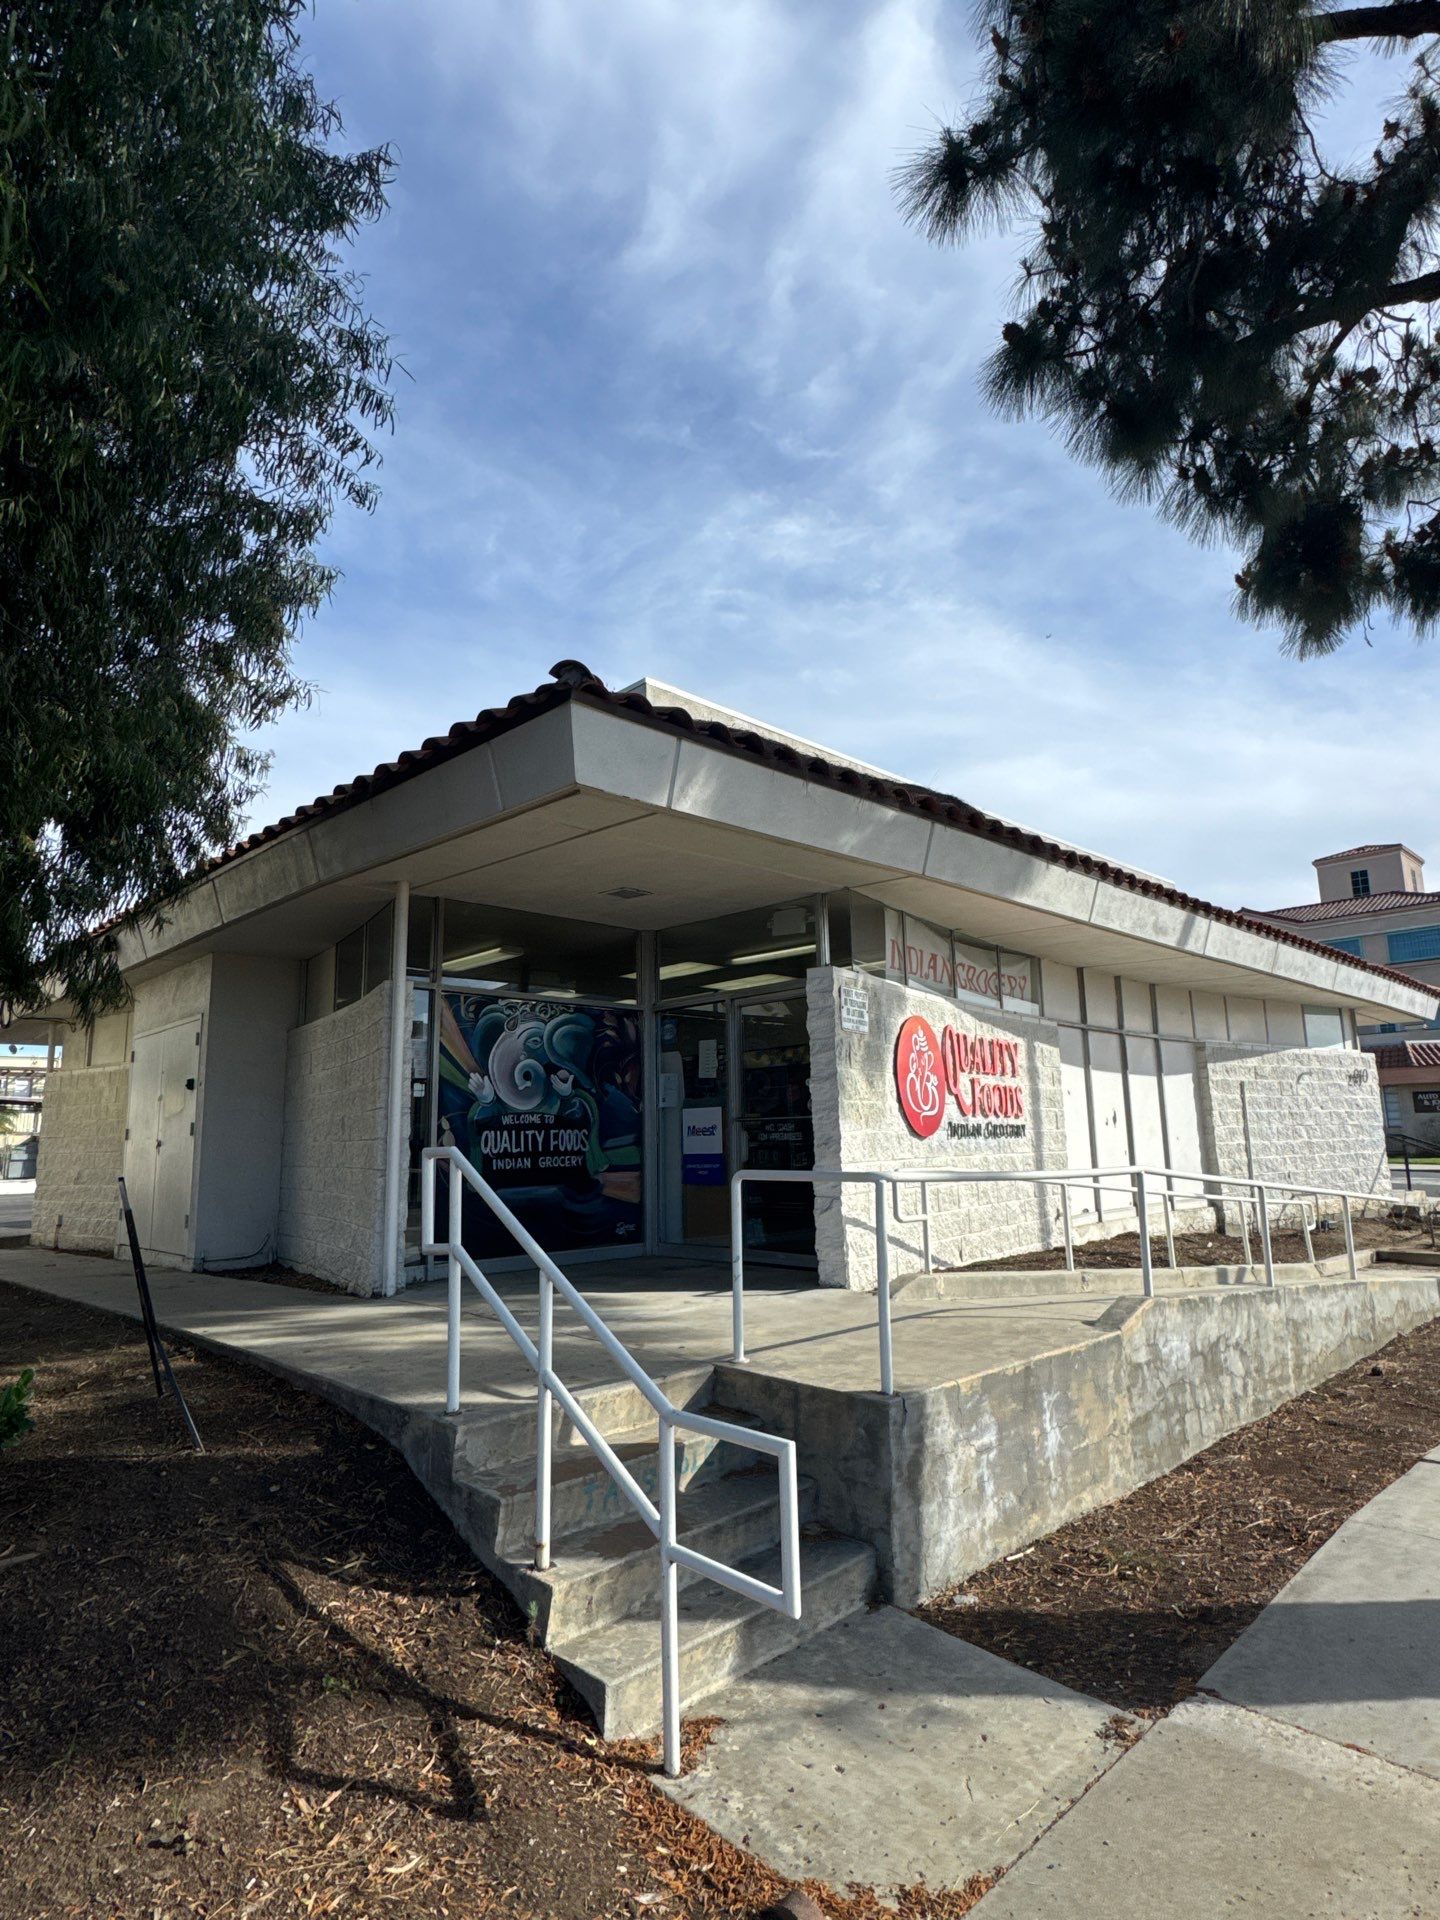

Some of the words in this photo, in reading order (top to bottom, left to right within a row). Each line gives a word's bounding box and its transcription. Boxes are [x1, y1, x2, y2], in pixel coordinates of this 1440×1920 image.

[941, 1024, 1019, 1117] QUALITY
[970, 1078, 1024, 1119] FOODS
[501, 1114, 542, 1125] WELCOME
[544, 1115, 555, 1124] TO
[687, 1125, 715, 1137] Meest
[946, 1121, 983, 1140] INDIAN
[983, 1122, 1026, 1139] GROCERY
[481, 1129, 545, 1158] QUALITY
[550, 1129, 589, 1152] FOODS
[492, 1157, 531, 1170] INDIAN
[538, 1155, 584, 1168] GROCERY
